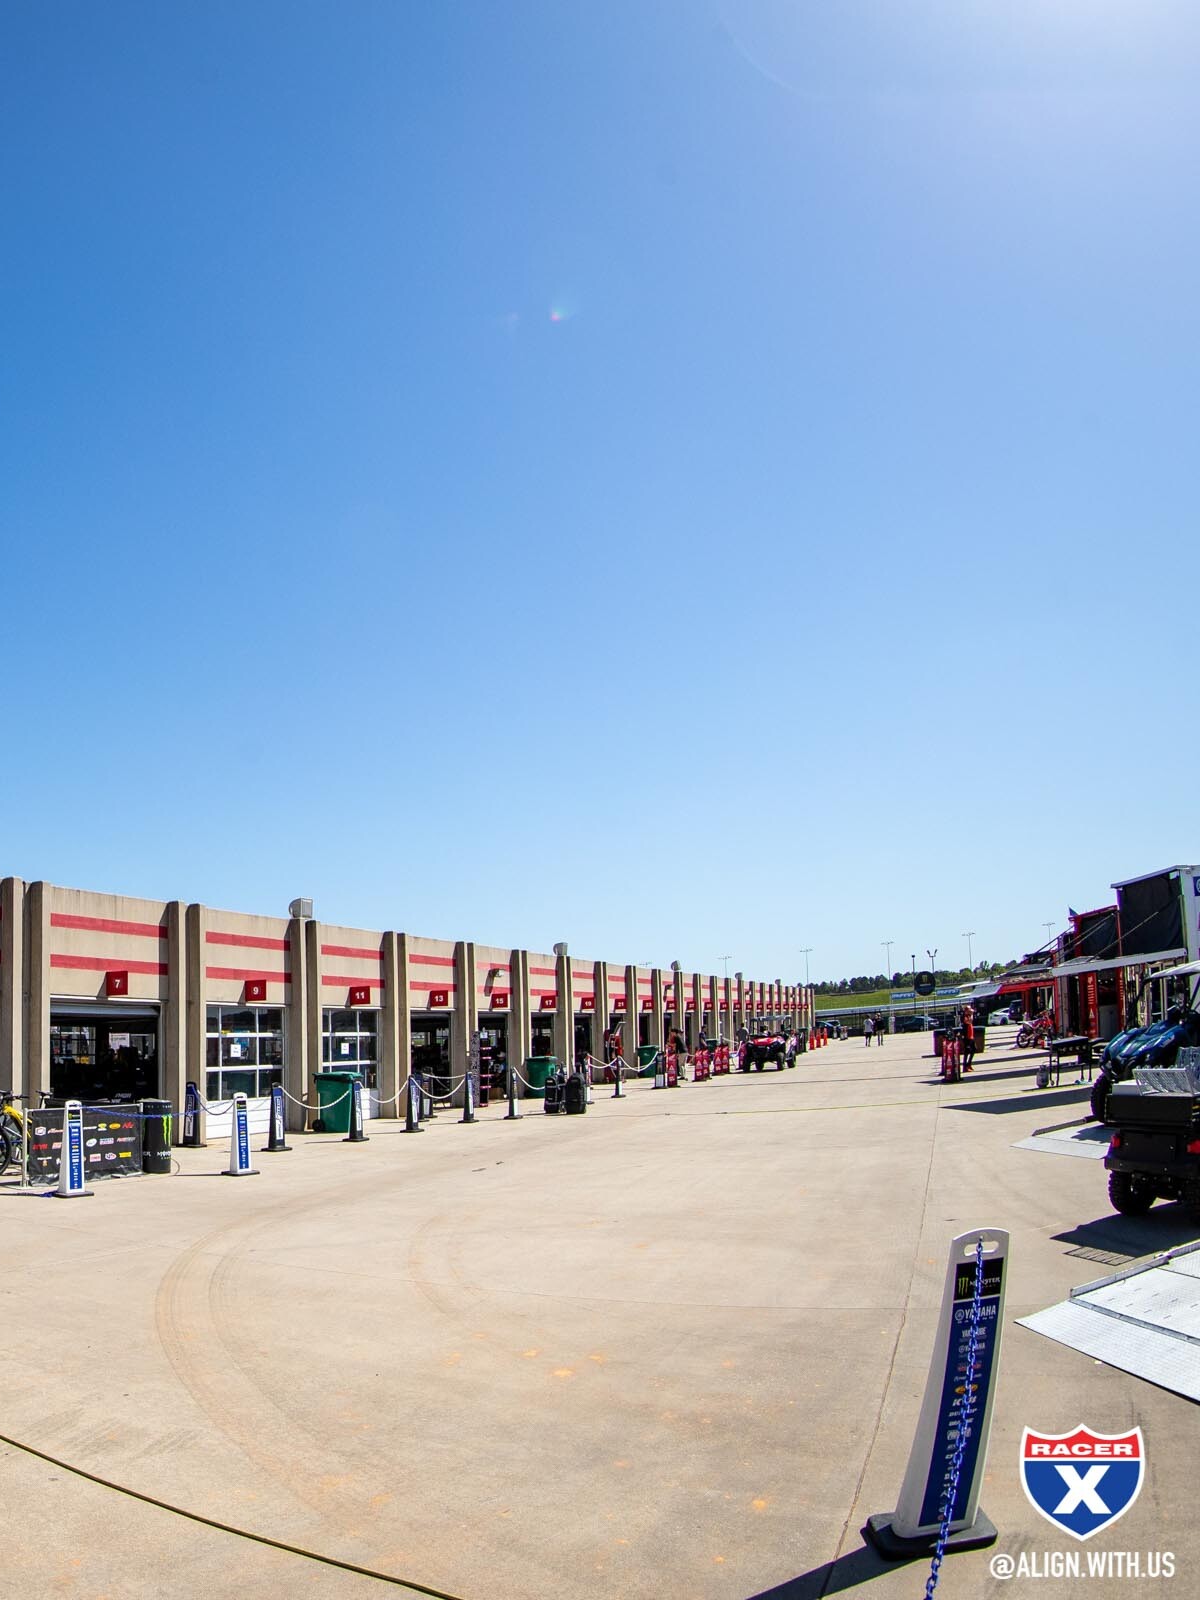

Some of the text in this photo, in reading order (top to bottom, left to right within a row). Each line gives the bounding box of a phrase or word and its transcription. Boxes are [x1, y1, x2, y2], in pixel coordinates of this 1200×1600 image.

[114, 979, 121, 989] 7
[252, 986, 260, 995] 9
[355, 991, 365, 1000] 11
[433, 994, 444, 1002] 13
